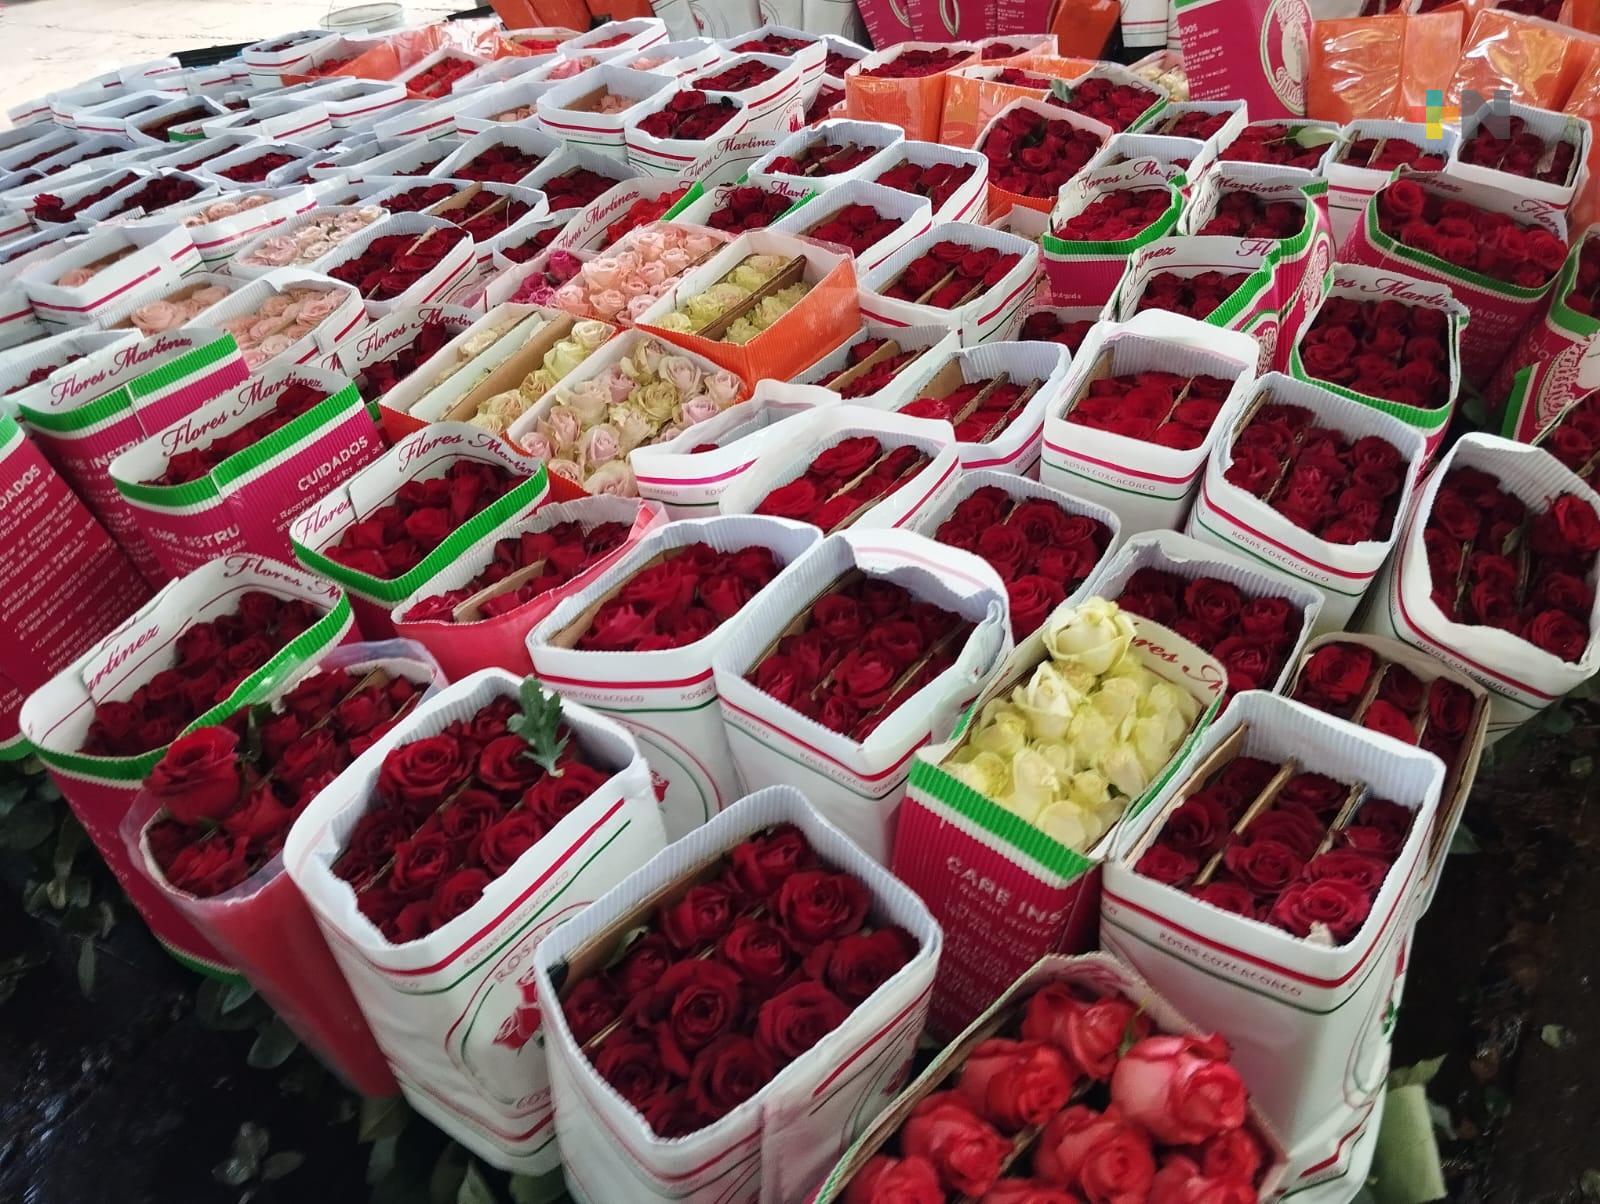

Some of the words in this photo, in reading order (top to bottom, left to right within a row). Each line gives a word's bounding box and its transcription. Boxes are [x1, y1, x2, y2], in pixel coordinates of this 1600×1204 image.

[684, 155, 713, 177] Flores
[356, 322, 408, 362] Flores
[51, 370, 107, 406] Flores
[161, 411, 229, 457] Flores
[398, 432, 464, 472] Flores
[297, 436, 369, 491] CUIDADOS
[294, 495, 352, 544] Flores
[1231, 530, 1261, 551] ROSAS
[223, 555, 303, 588] Flores
[946, 856, 1011, 907] CARE
